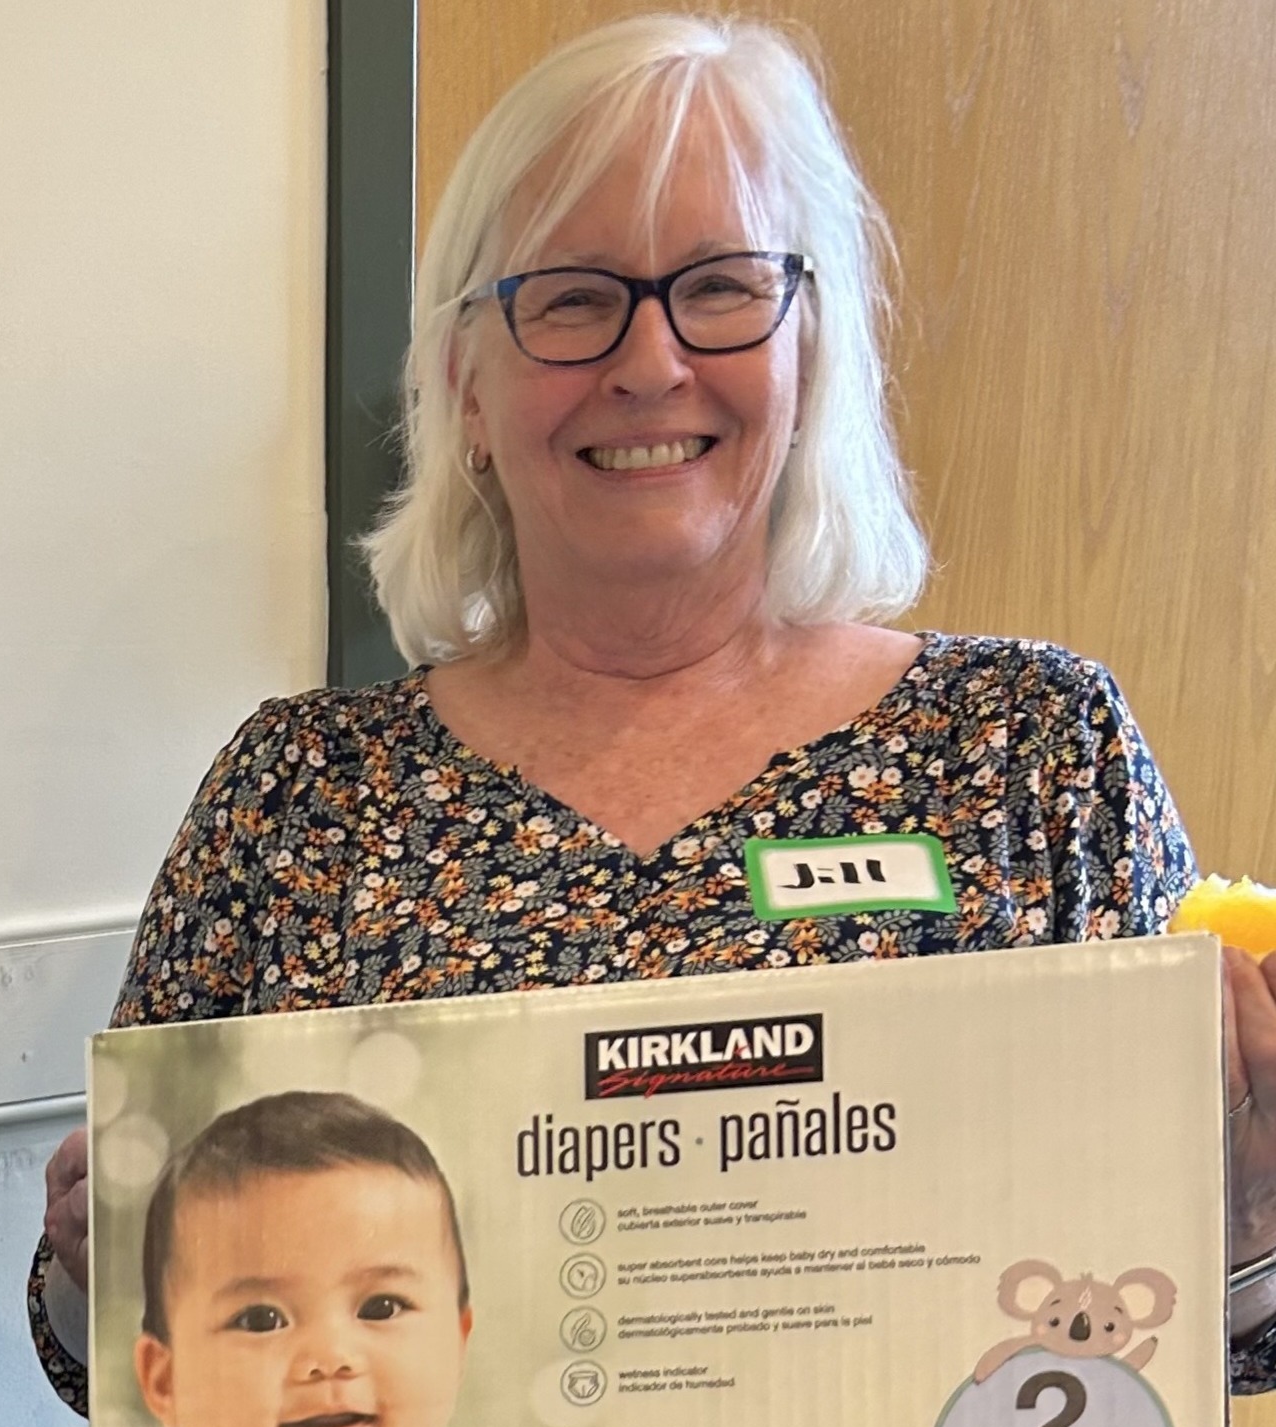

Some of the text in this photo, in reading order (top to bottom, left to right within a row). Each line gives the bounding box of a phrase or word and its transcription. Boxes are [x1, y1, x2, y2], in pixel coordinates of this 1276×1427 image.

[597, 1023, 814, 1071] KIRKLAND
[598, 1062, 814, 1098] Signature
[516, 1093, 898, 1182] diapers pañales
[642, 1200, 759, 1216] breathable outer cover
[617, 1210, 808, 1232] cubierta exterior transpirable
[618, 1242, 926, 1273] super absorbent keep baby dry and comfortable
[669, 1267, 758, 1283] superabsorbente
[617, 1303, 835, 1327] dermatologically tested and gentle on skin
[617, 1314, 873, 1340] dermatológicamente probado suave para piel
[618, 1365, 709, 1380] wetness indicator
[618, 1377, 736, 1393] indicador de humedad
